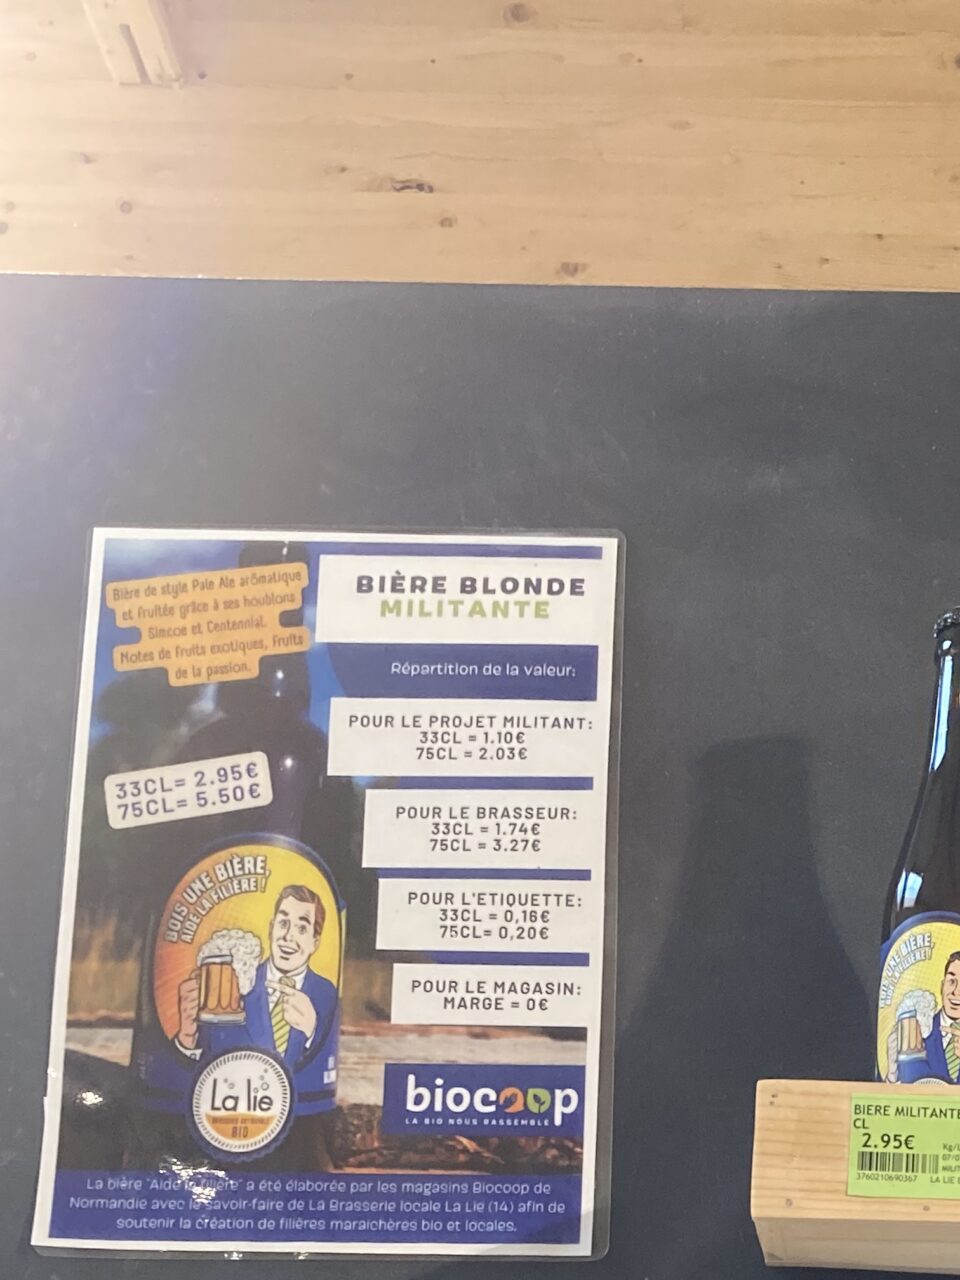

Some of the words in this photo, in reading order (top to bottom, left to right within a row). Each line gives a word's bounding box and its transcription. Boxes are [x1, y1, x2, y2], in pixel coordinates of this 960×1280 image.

[356, 570, 447, 594] BIÈRE
[460, 576, 585, 596] BLONDE
[380, 599, 550, 619] MILITANTE
[148, 625, 187, 639] Simcoe
[192, 623, 203, 635] et
[175, 667, 188, 679] de
[192, 665, 201, 677] la
[391, 662, 478, 677] Répartition
[483, 663, 501, 676] de
[506, 664, 519, 676] la
[524, 664, 575, 677] valeur:
[349, 715, 394, 728] POUR
[401, 715, 422, 728] LE
[429, 715, 496, 728] PROJET
[503, 716, 593, 730] MILITANT:
[419, 732, 462, 744] 33CL
[483, 732, 525, 744] 1.10€
[416, 747, 457, 760] 75CL
[479, 747, 527, 760] 2.03€
[194, 763, 259, 787] 2.95€
[196, 783, 261, 808] 5.50€
[396, 806, 442, 819] POUR
[449, 807, 470, 819] LE
[476, 807, 578, 820] BRASSEUR:
[408, 892, 454, 905] POUR
[462, 893, 582, 907] L'ETIQUETTE:
[411, 980, 458, 993] POUR
[465, 981, 486, 993] LE
[493, 981, 581, 995] MAGASIN:
[443, 997, 504, 1010] MARGE
[526, 998, 548, 1011] 0€
[211, 1078, 239, 1112] La
[247, 1078, 273, 1112] lie
[406, 1074, 579, 1127] biocoop
[854, 1104, 891, 1116] BIERE
[853, 1119, 869, 1129] CL
[232, 1126, 248, 1138] BIO
[862, 1133, 915, 1150] 2.95€
[116, 1218, 175, 1229] soutenir
[180, 1218, 191, 1229] la
[196, 1216, 254, 1229] création
[258, 1218, 275, 1230] de
[279, 1218, 325, 1230] filières
[421, 1220, 443, 1231] bio
[447, 1221, 461, 1232] et
[466, 1220, 517, 1232] locales.
